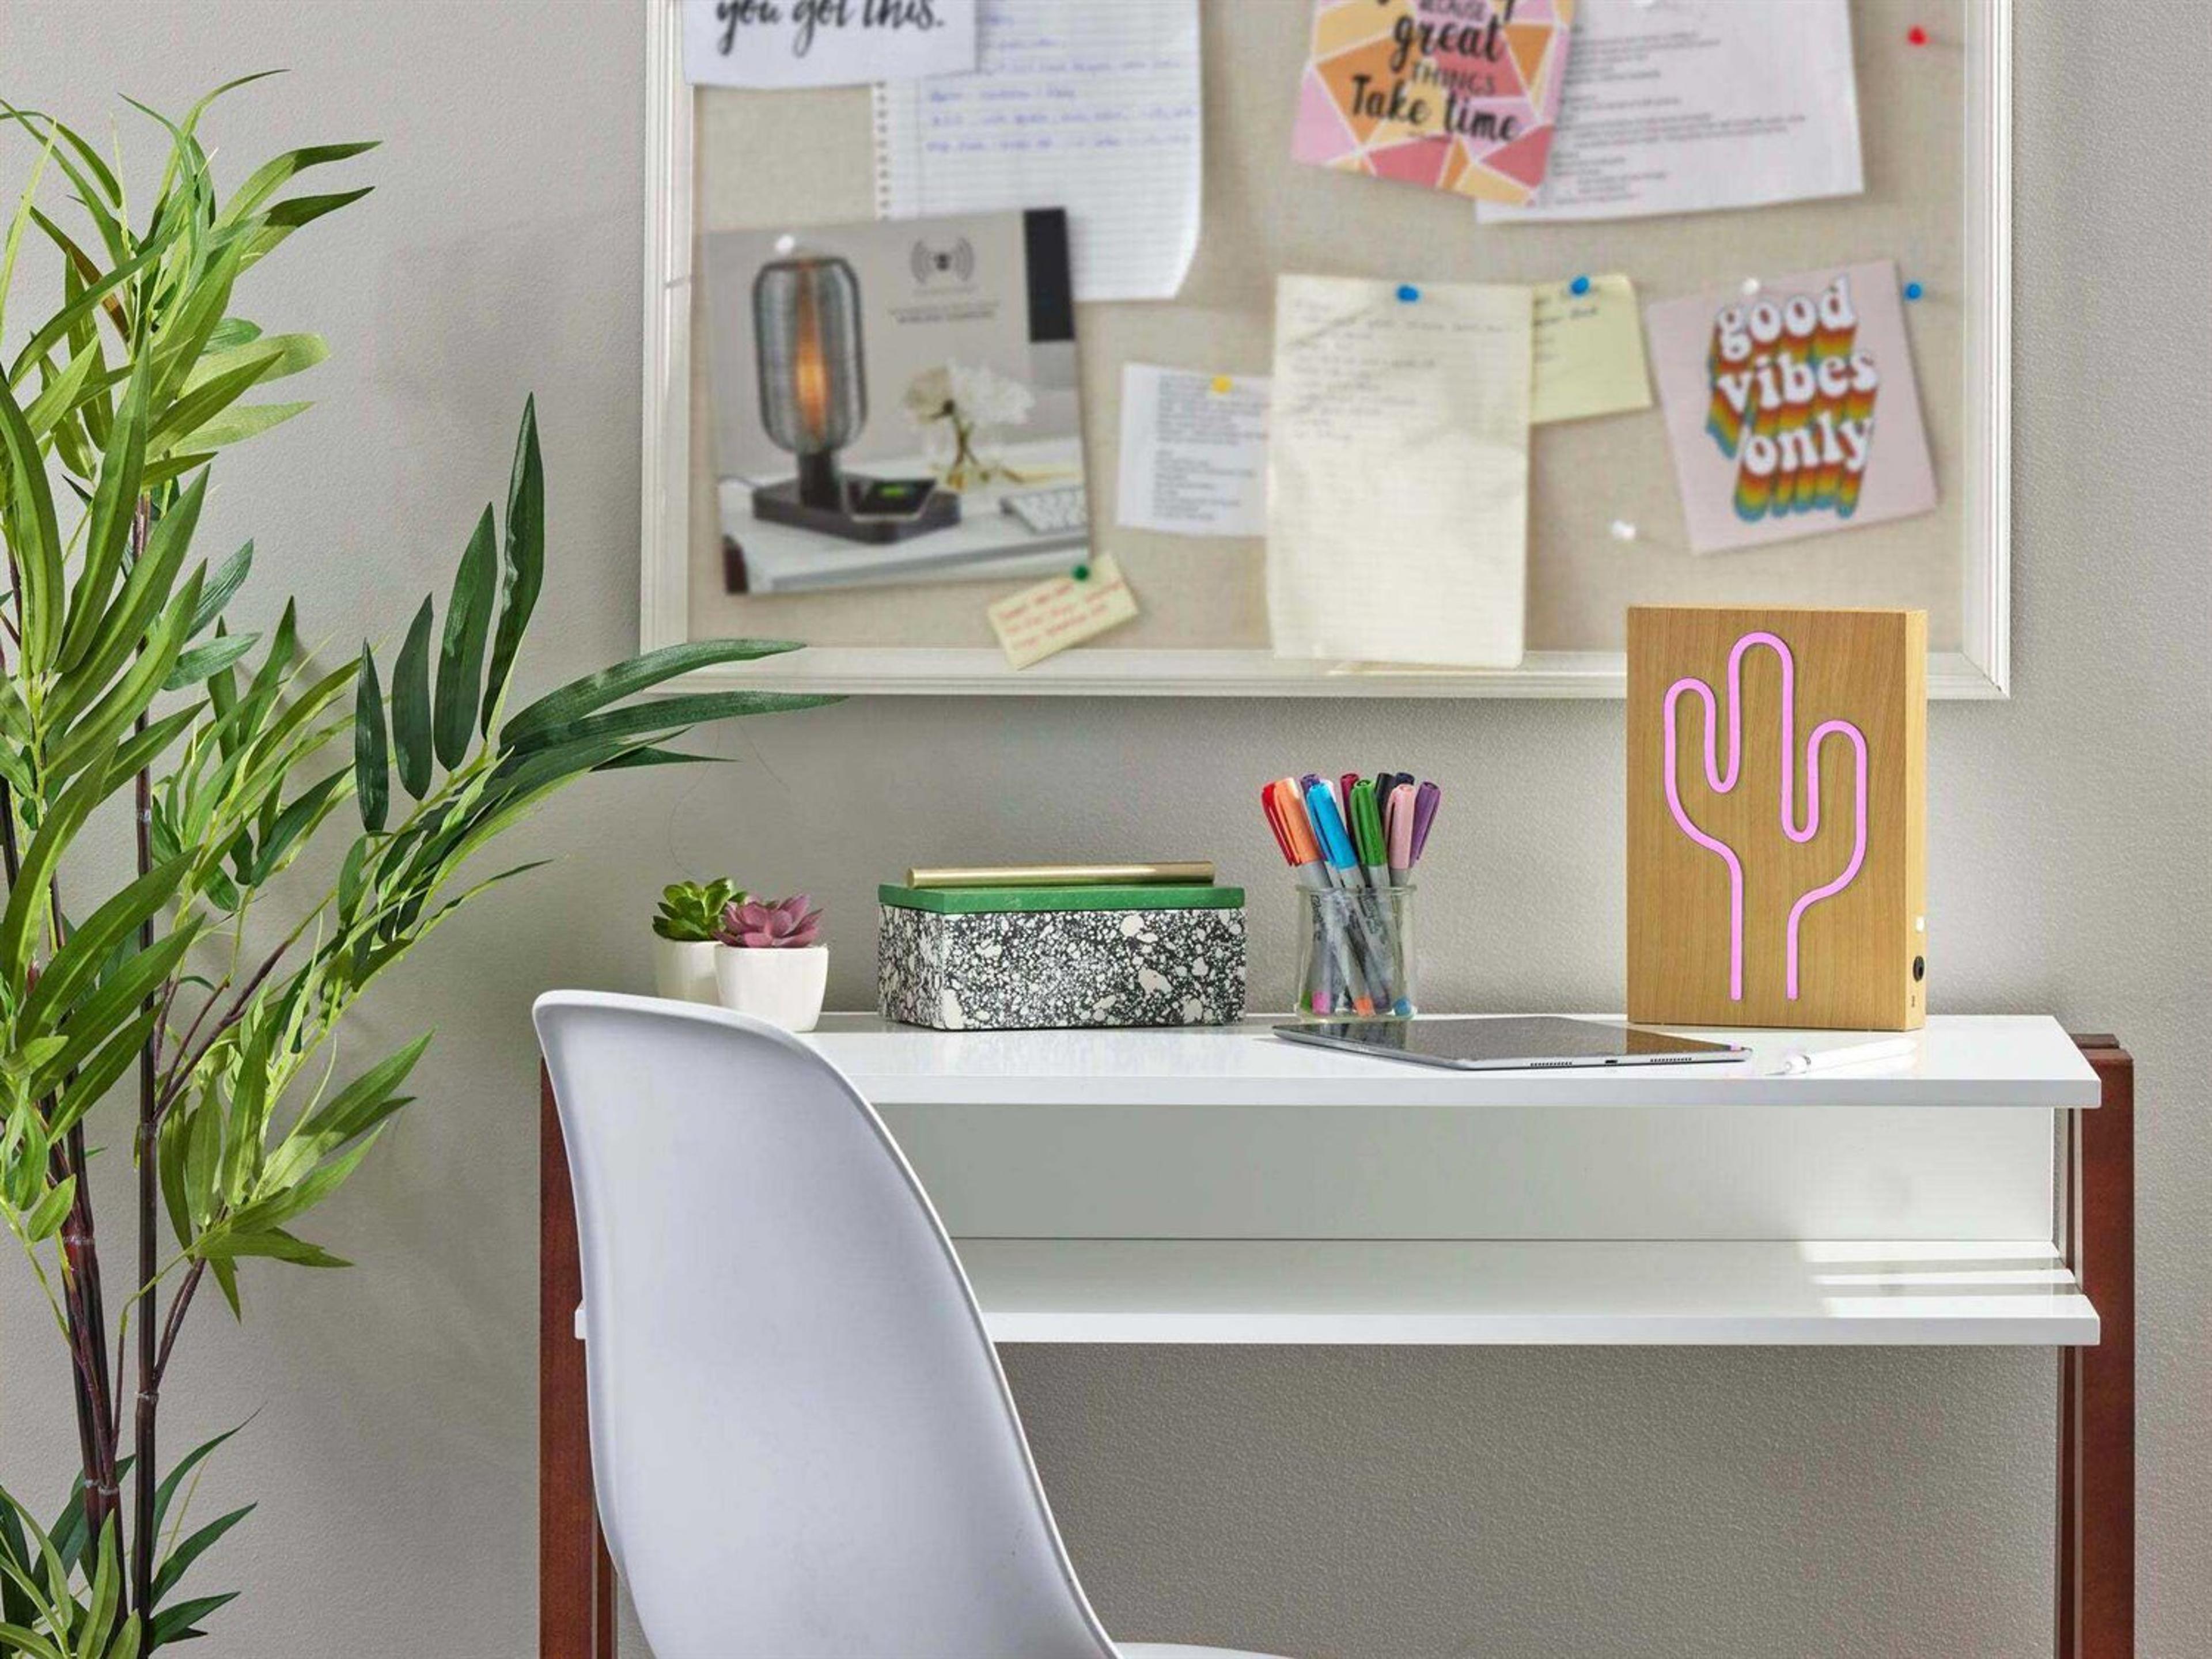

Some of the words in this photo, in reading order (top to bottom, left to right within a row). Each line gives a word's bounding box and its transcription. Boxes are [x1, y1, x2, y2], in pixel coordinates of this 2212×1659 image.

[716, 0, 782, 56] you
[791, 0, 854, 56] got
[1389, 14, 1503, 73] great
[1352, 73, 1429, 125] Take
[1444, 90, 1520, 142] time
[1412, 61, 1497, 96] THINGS
[1714, 273, 1856, 361] good
[1718, 351, 1878, 414] vibes
[1743, 412, 1871, 475] only
